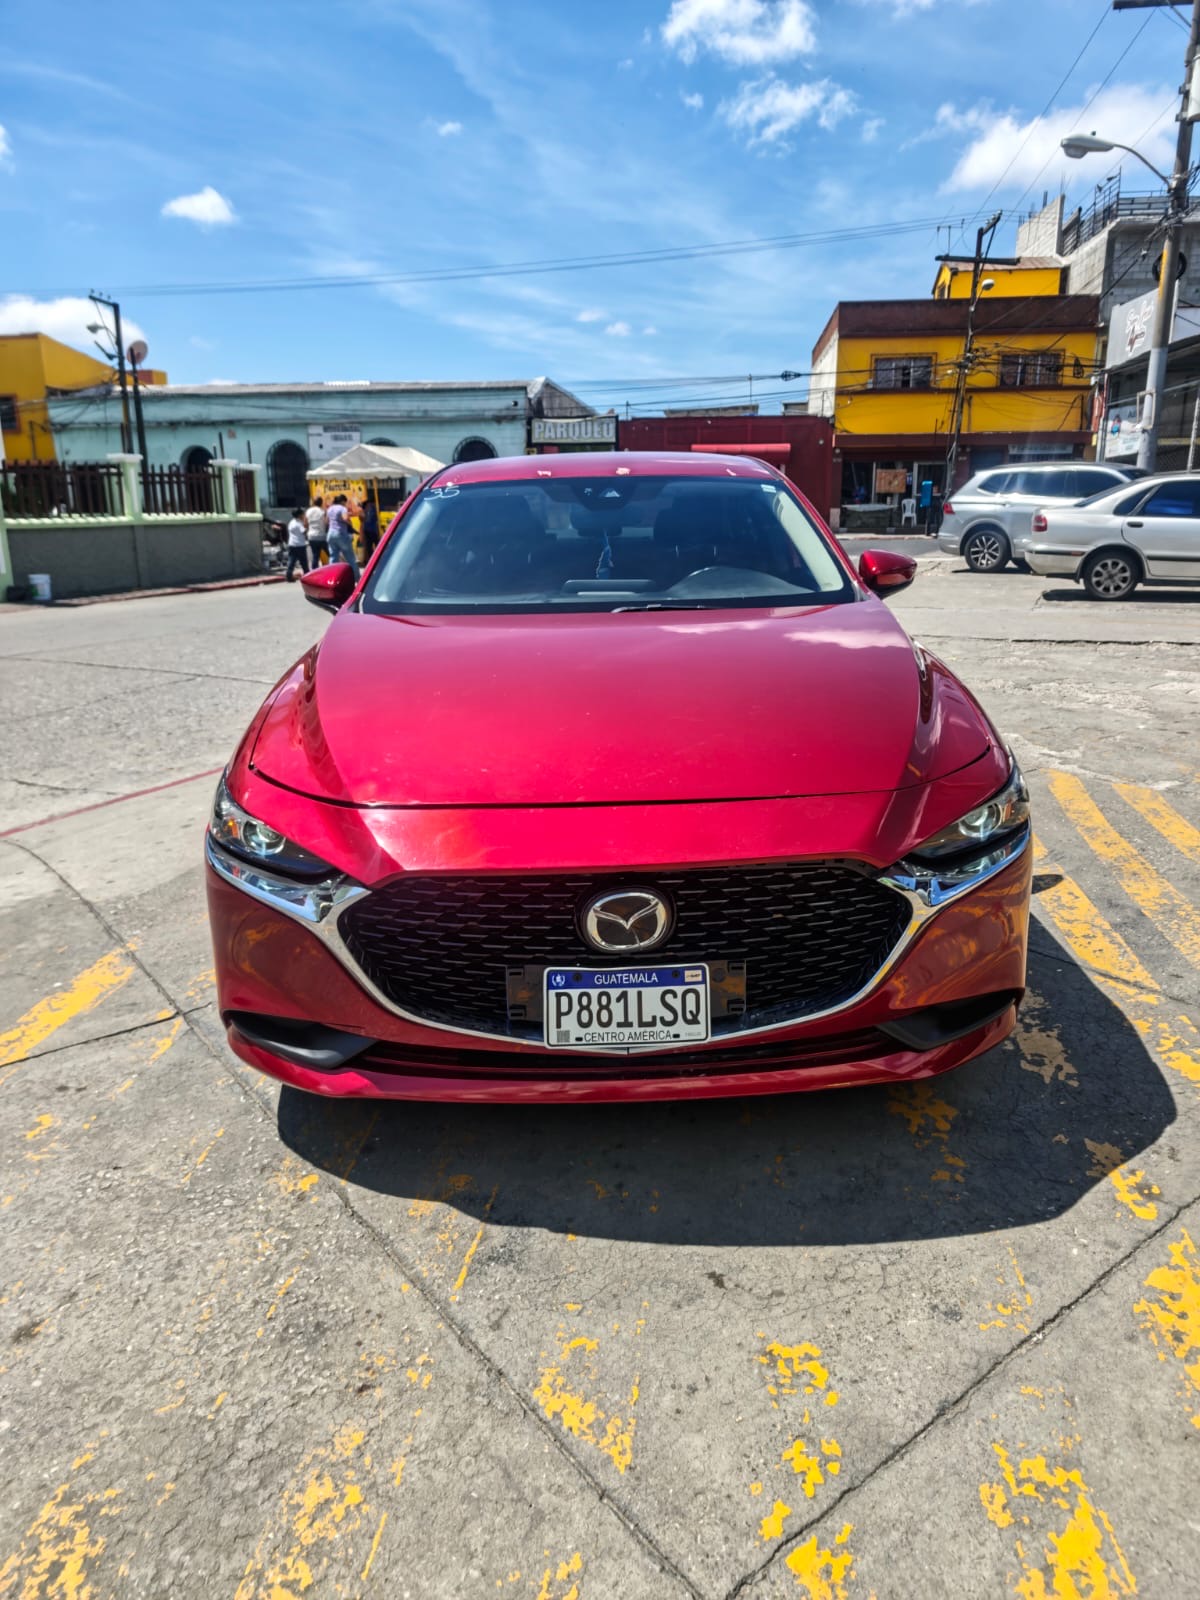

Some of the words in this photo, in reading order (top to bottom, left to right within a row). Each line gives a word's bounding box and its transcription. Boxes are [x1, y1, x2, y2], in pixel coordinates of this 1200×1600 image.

[534, 421, 614, 440] PARQUEO
[594, 973, 658, 985] GUATEMALA
[555, 988, 701, 1029] P881LSQ
[584, 1032, 625, 1042] CENTRO
